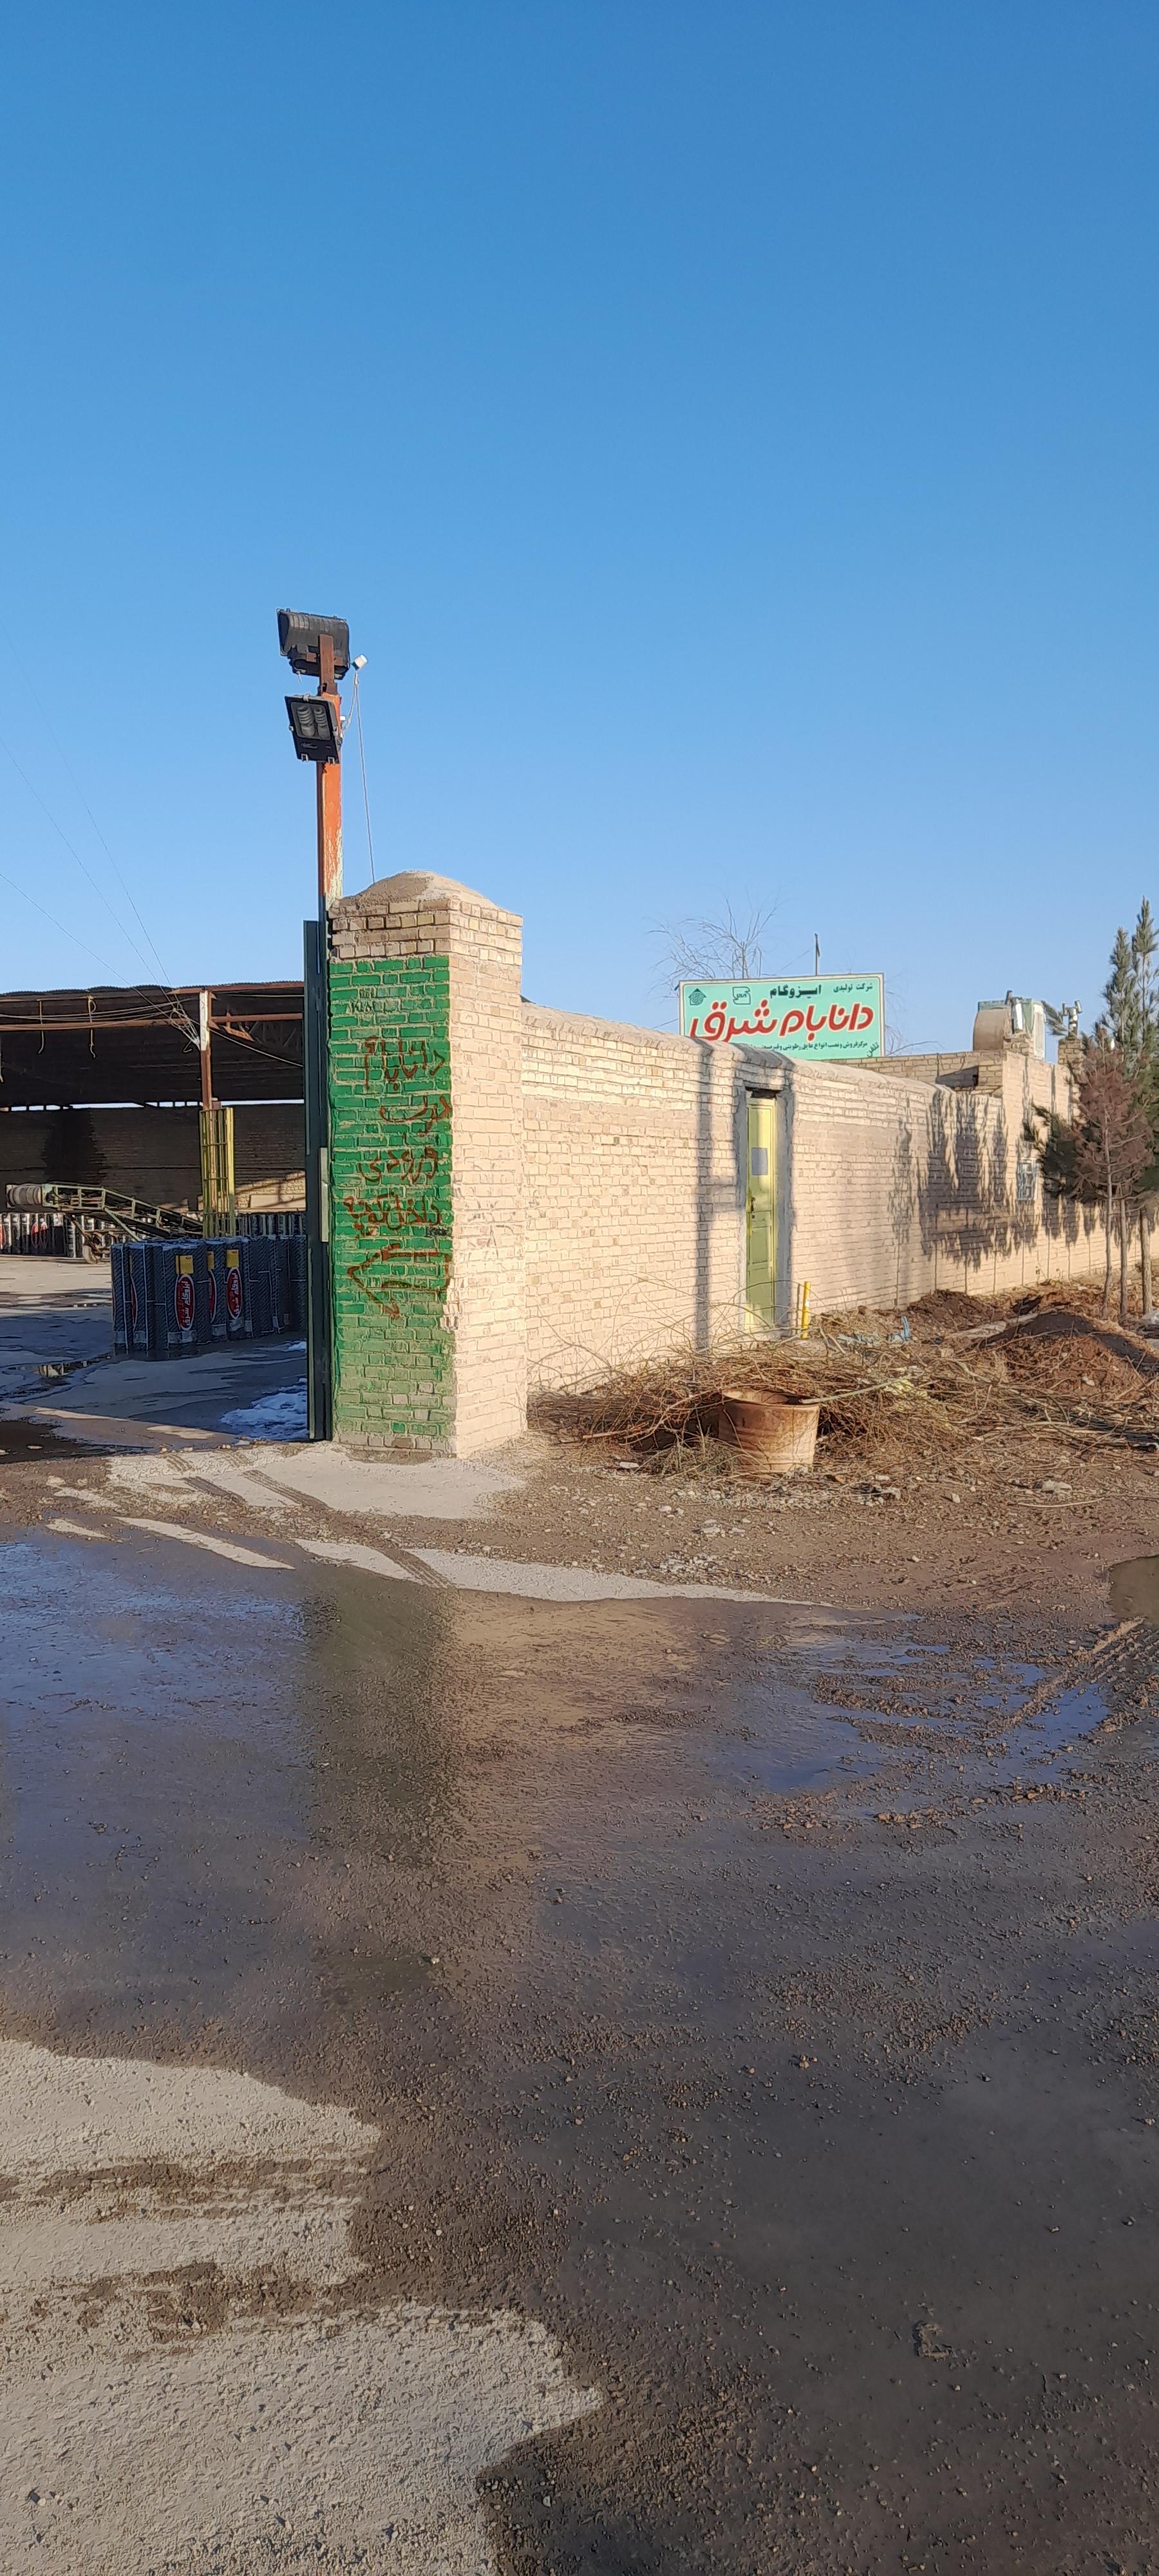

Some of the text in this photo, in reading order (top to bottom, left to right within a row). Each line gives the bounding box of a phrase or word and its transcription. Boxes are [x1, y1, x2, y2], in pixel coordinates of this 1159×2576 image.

[770, 984, 822, 999] ایزوگام
[833, 982, 873, 993] شرکت تولیدی
[690, 999, 777, 1043] شرق
